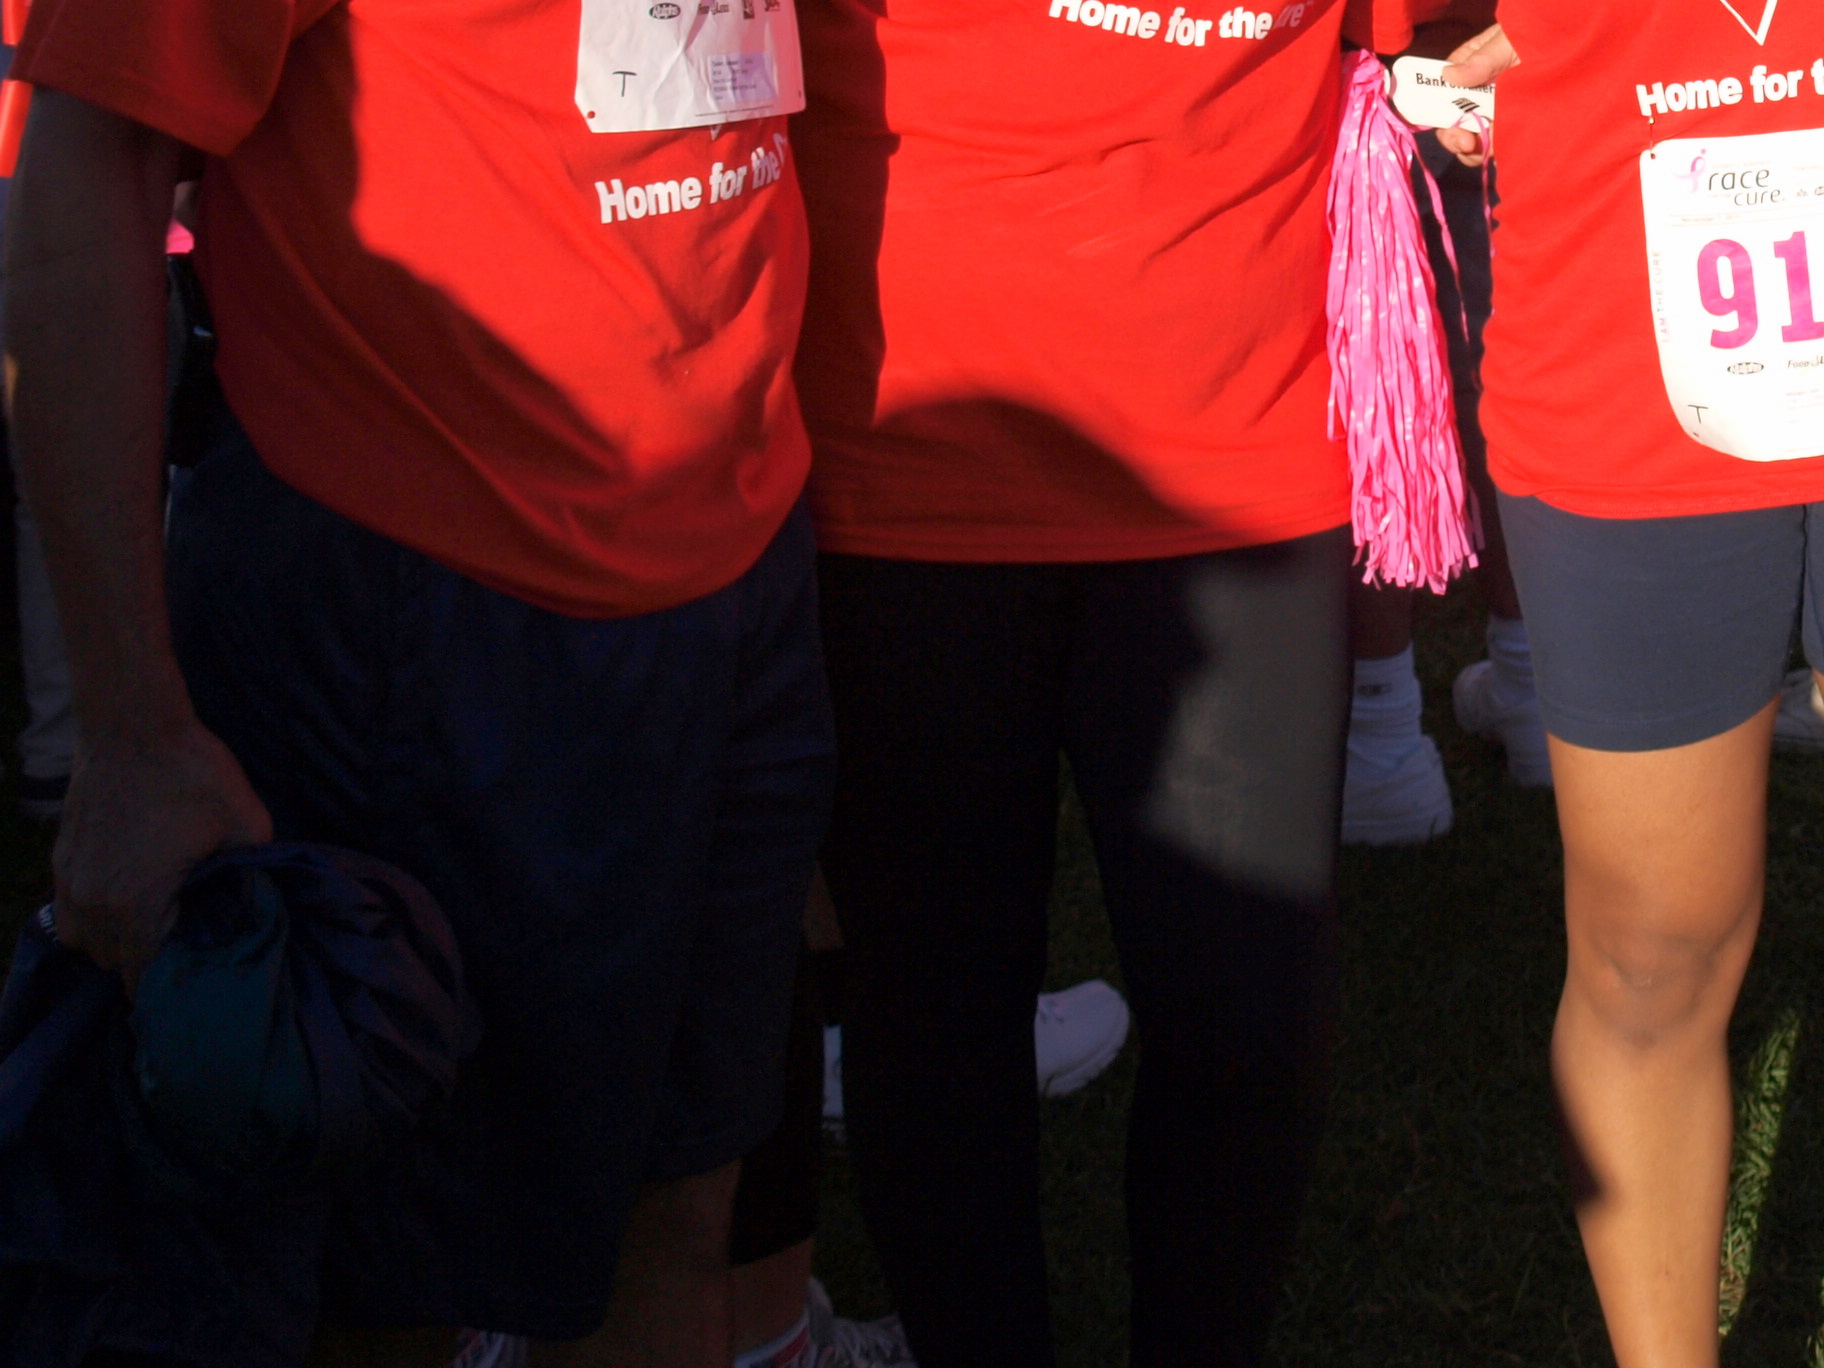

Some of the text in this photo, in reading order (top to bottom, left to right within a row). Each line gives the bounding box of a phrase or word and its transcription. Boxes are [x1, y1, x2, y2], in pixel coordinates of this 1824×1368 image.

[1165, 7, 1212, 47] for
[1219, 6, 1273, 41] the
[612, 70, 637, 97] T
[1415, 72, 1447, 88] Bank
[1636, 79, 1743, 118] Home
[1750, 65, 1804, 103] for
[595, 176, 703, 224] Home
[709, 161, 747, 205] for
[751, 147, 781, 189] the
[1708, 168, 1770, 192] race
[1688, 404, 1708, 423] T
